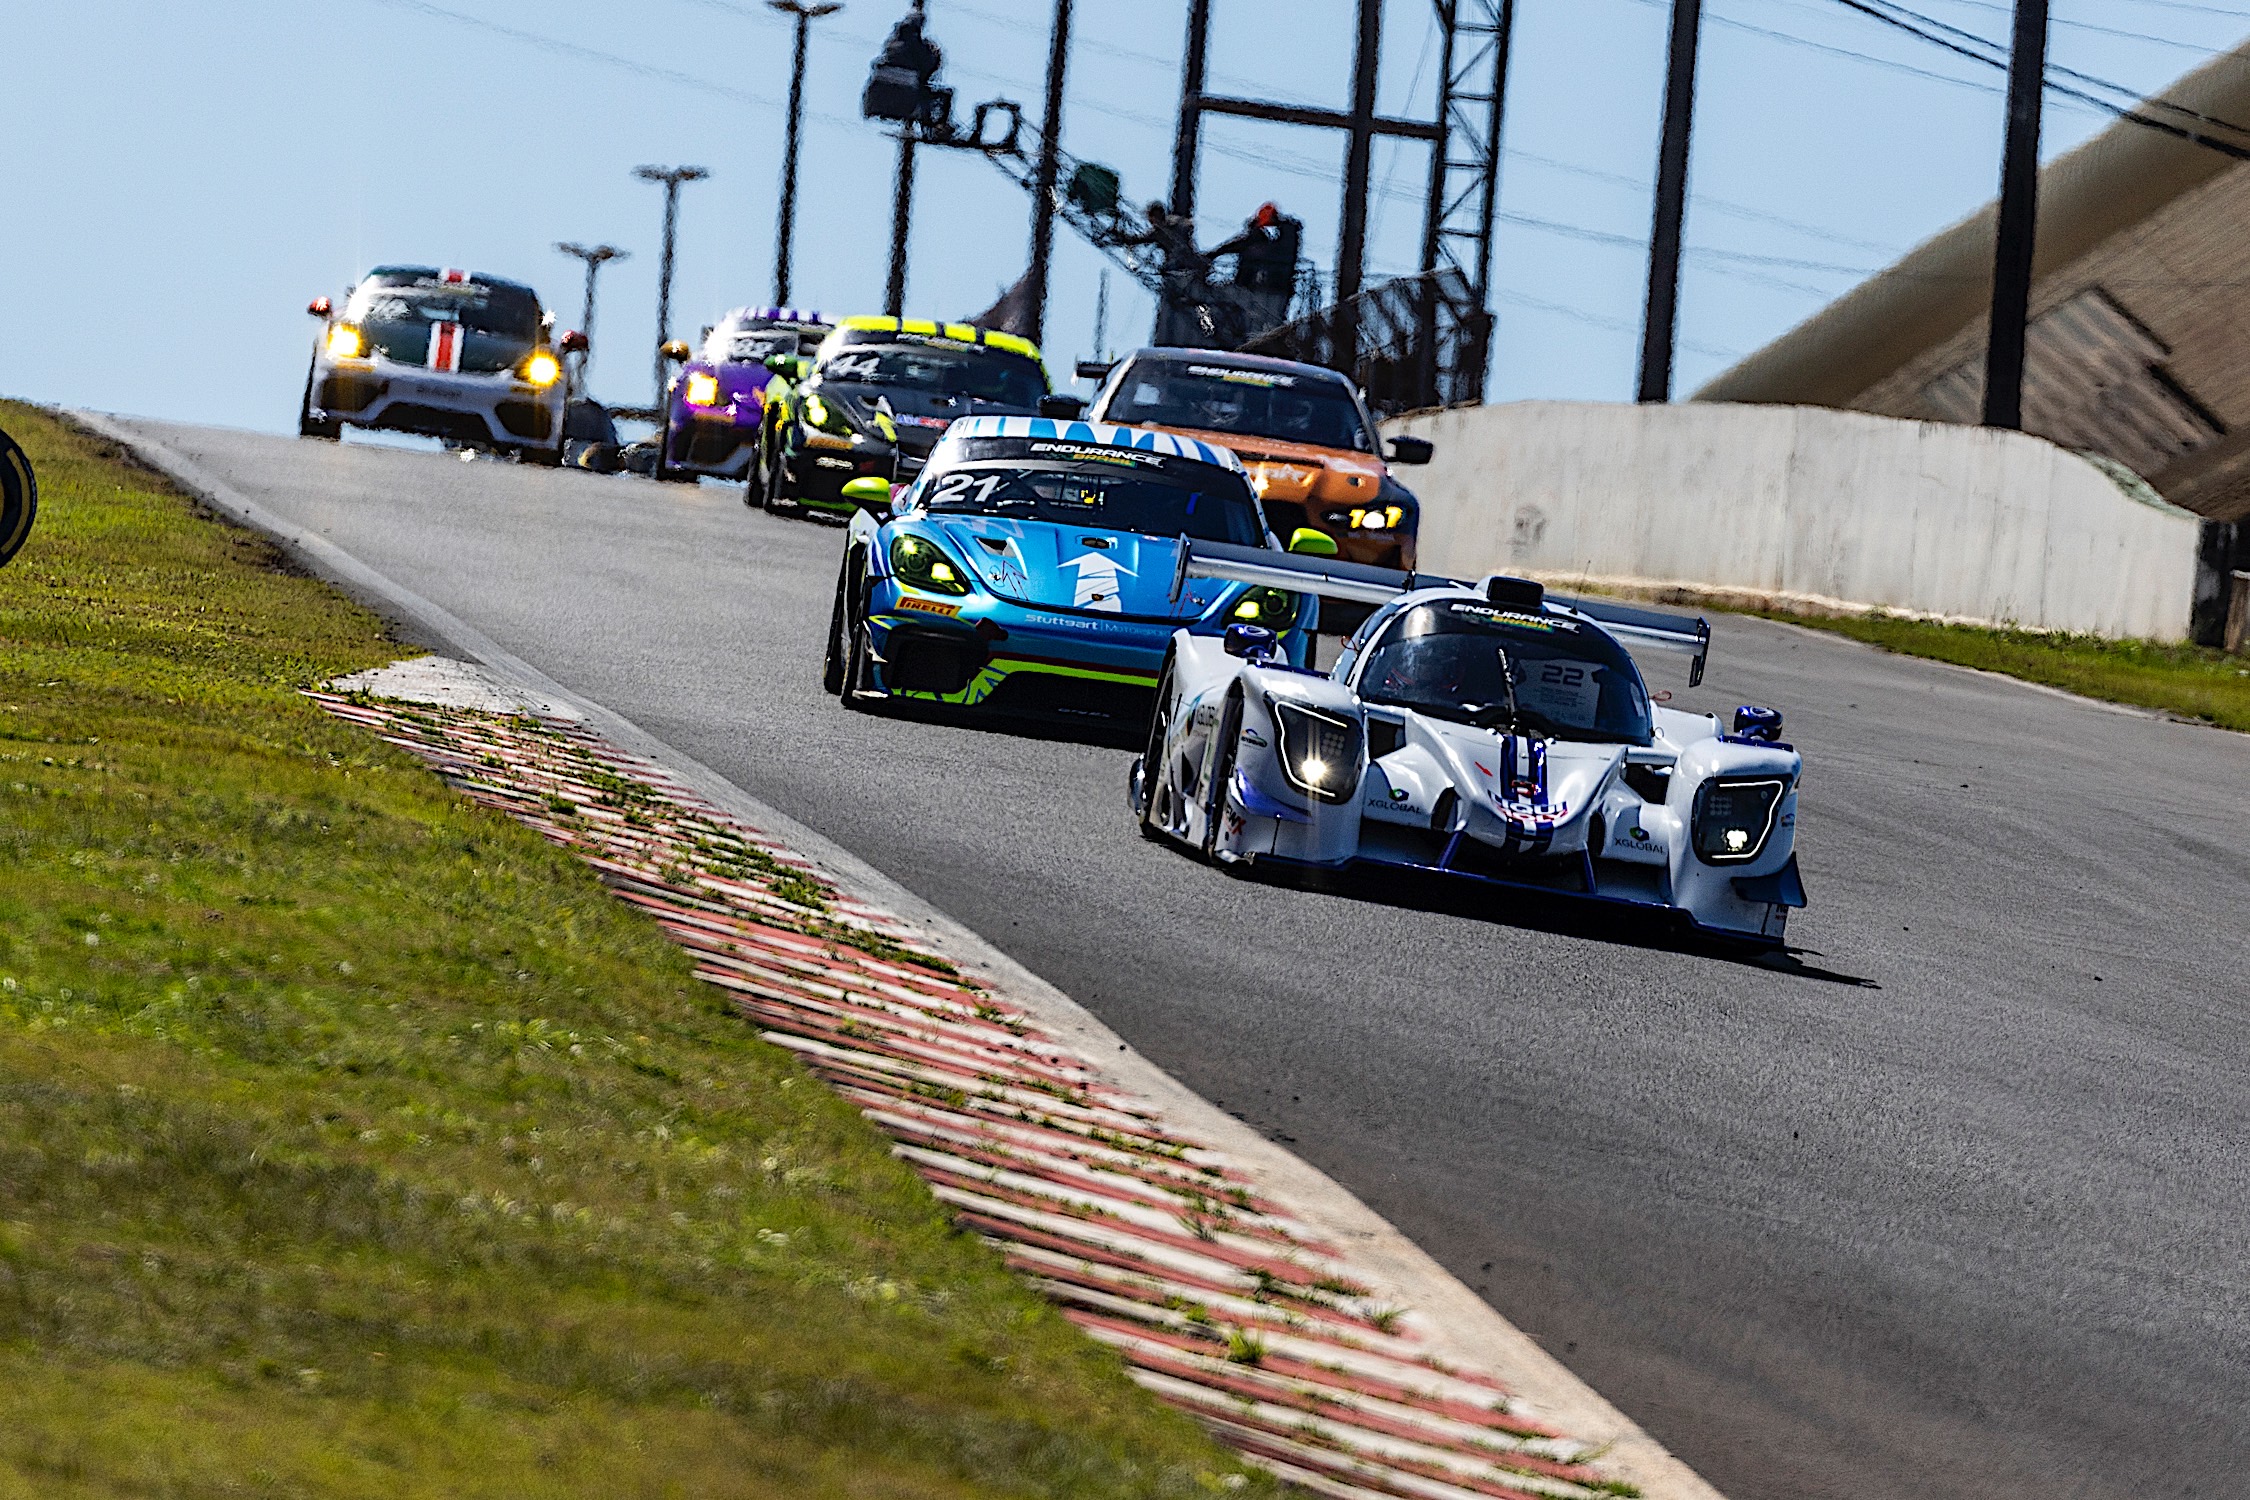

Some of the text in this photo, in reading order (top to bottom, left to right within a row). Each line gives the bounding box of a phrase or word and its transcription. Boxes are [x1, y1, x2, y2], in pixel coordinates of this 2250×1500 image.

[1030, 443, 1167, 469] ENDURANCE
[930, 474, 1000, 503] 21
[900, 596, 957, 616] PIRELLI
[1024, 613, 1098, 630] Stuttgart
[1451, 603, 1582, 634] ENDURANCE
[1542, 664, 1584, 687] 22
[1368, 798, 1422, 815] XGLOBAL
[1487, 788, 1567, 815] LIQUI
[1615, 837, 1667, 855] XGLOBAL
